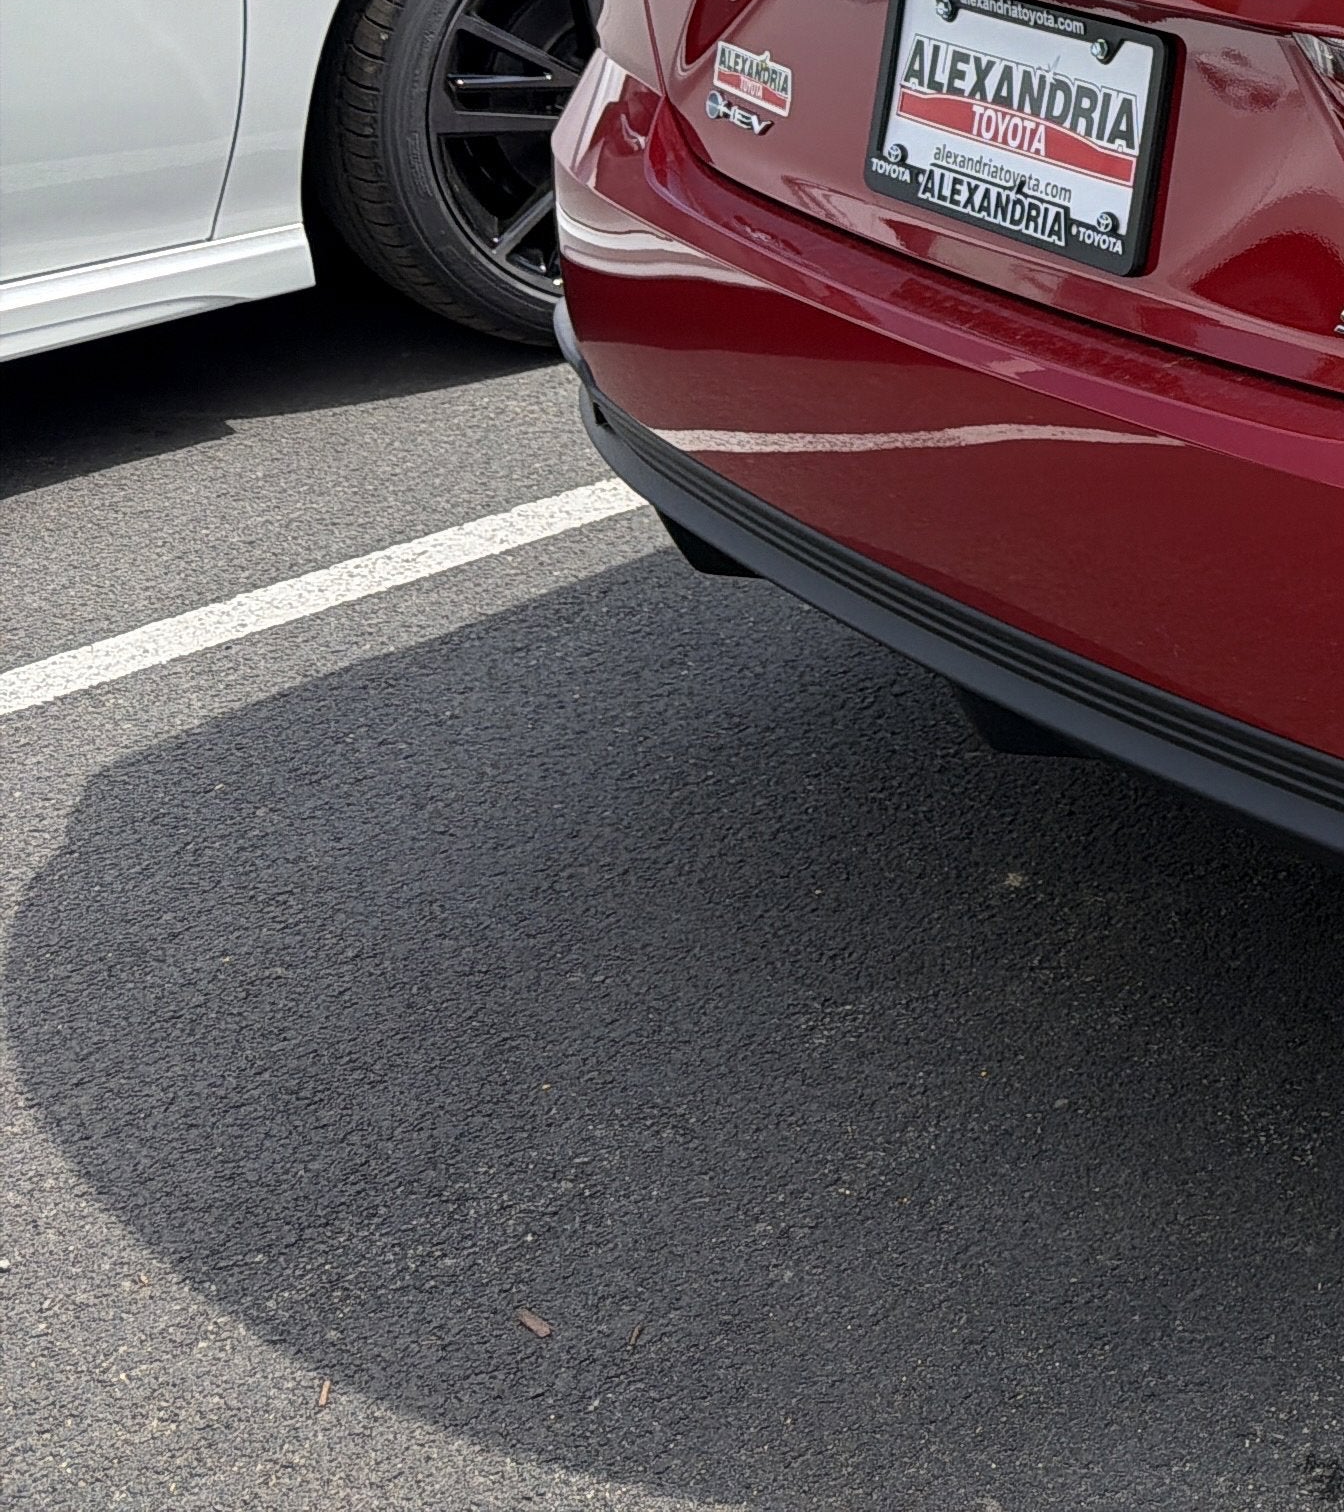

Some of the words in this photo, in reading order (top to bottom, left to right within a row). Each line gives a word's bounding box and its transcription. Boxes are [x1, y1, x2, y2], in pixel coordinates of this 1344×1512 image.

[718, 46, 789, 96] ALEXANDRIA
[902, 35, 1139, 153] ALEXANDRIA
[971, 104, 1047, 157] TOYOTA
[933, 144, 1073, 204] alexandriatoyota.com
[870, 158, 911, 184] TOYOTA
[918, 168, 1067, 247] ALEXANDRIA
[1078, 226, 1124, 255] TOYOTA
